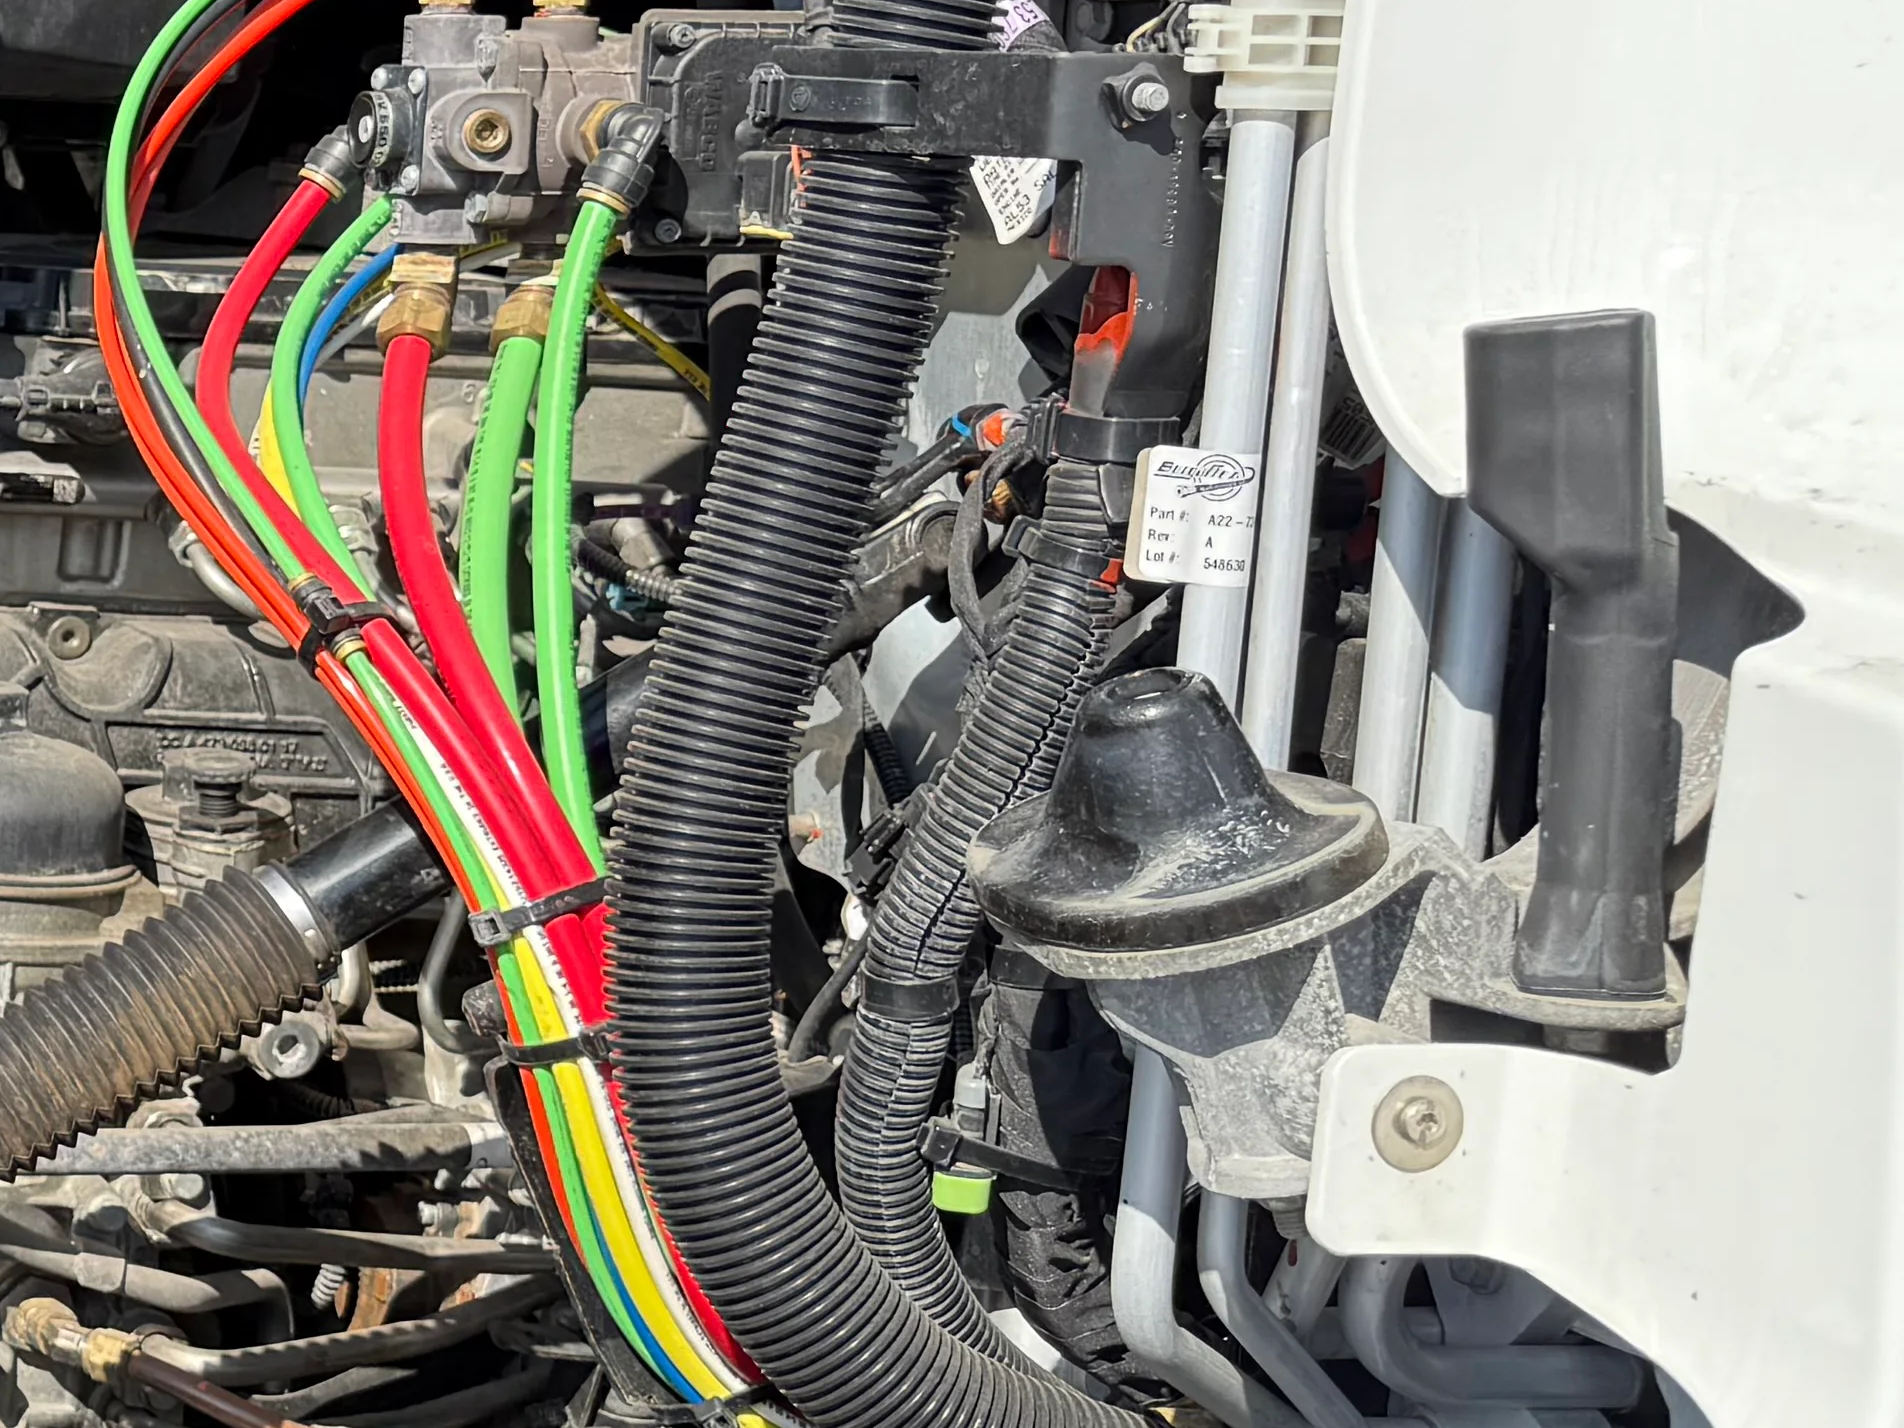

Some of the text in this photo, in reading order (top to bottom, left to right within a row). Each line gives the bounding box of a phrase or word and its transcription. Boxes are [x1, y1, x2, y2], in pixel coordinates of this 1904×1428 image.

[1150, 506, 1175, 520] Part
[1205, 536, 1213, 548] A
[1146, 549, 1164, 562] Lot
